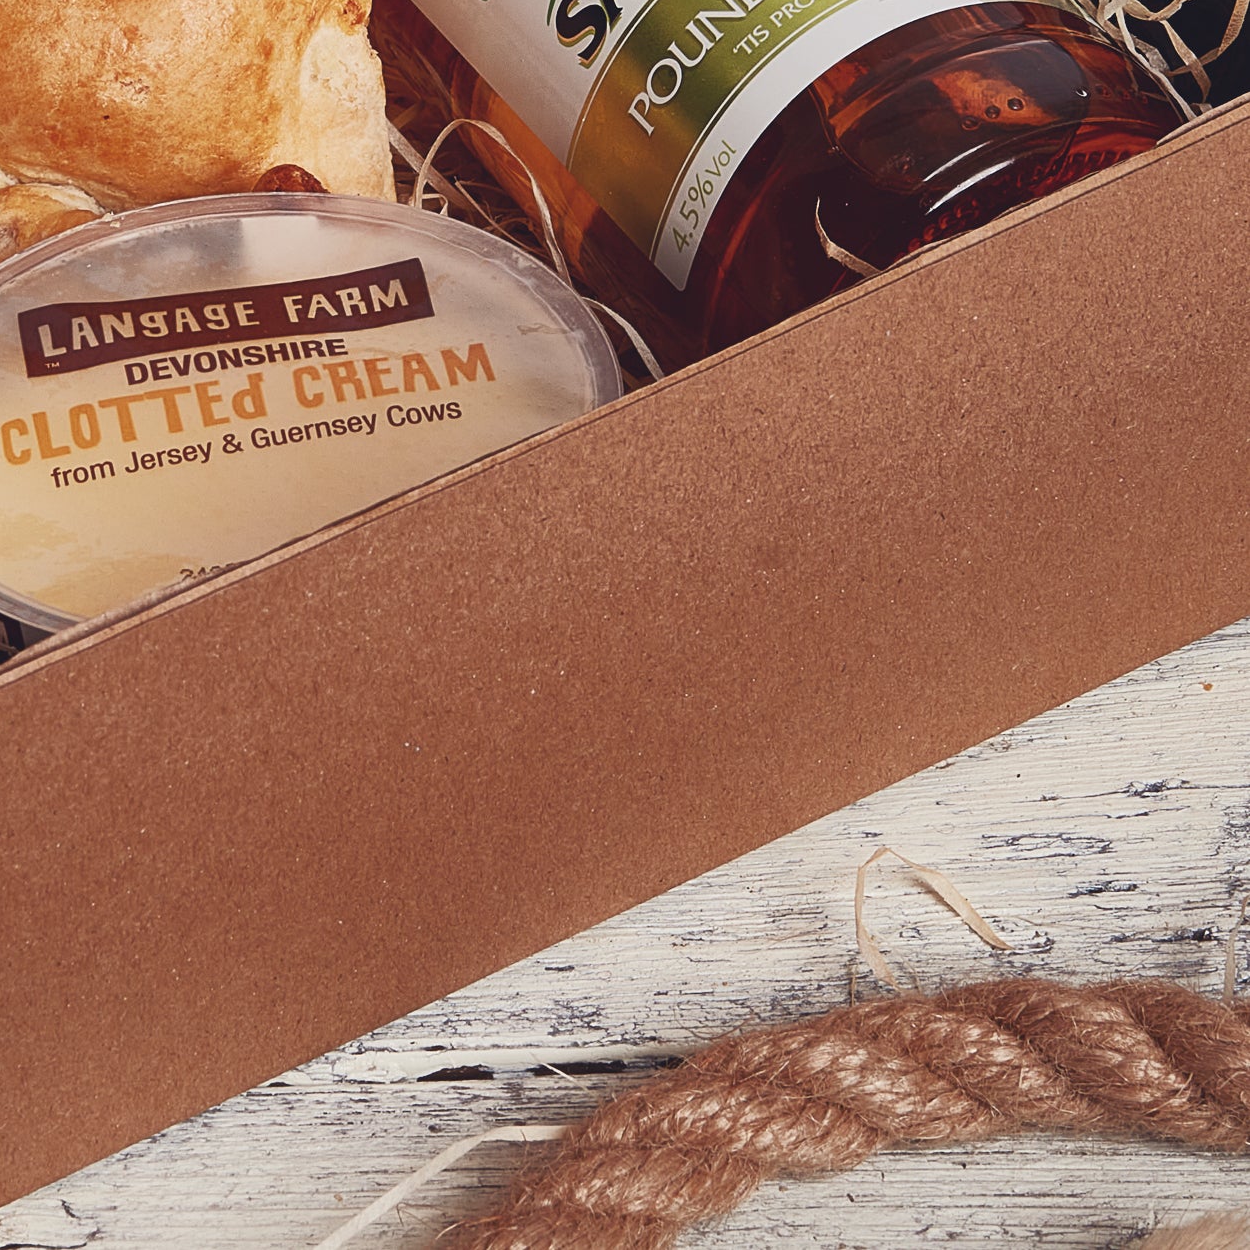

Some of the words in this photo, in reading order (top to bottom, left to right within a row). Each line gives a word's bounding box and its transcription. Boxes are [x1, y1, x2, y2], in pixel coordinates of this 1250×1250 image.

[283, 278, 410, 324] FARM
[123, 338, 350, 386] DEVONSHIRE
[291, 342, 497, 409] CREAM
[50, 456, 116, 488] from
[124, 437, 213, 475] Jersey
[222, 433, 245, 454] &
[249, 413, 378, 451] Guernsey
[386, 400, 464, 426] Cows
